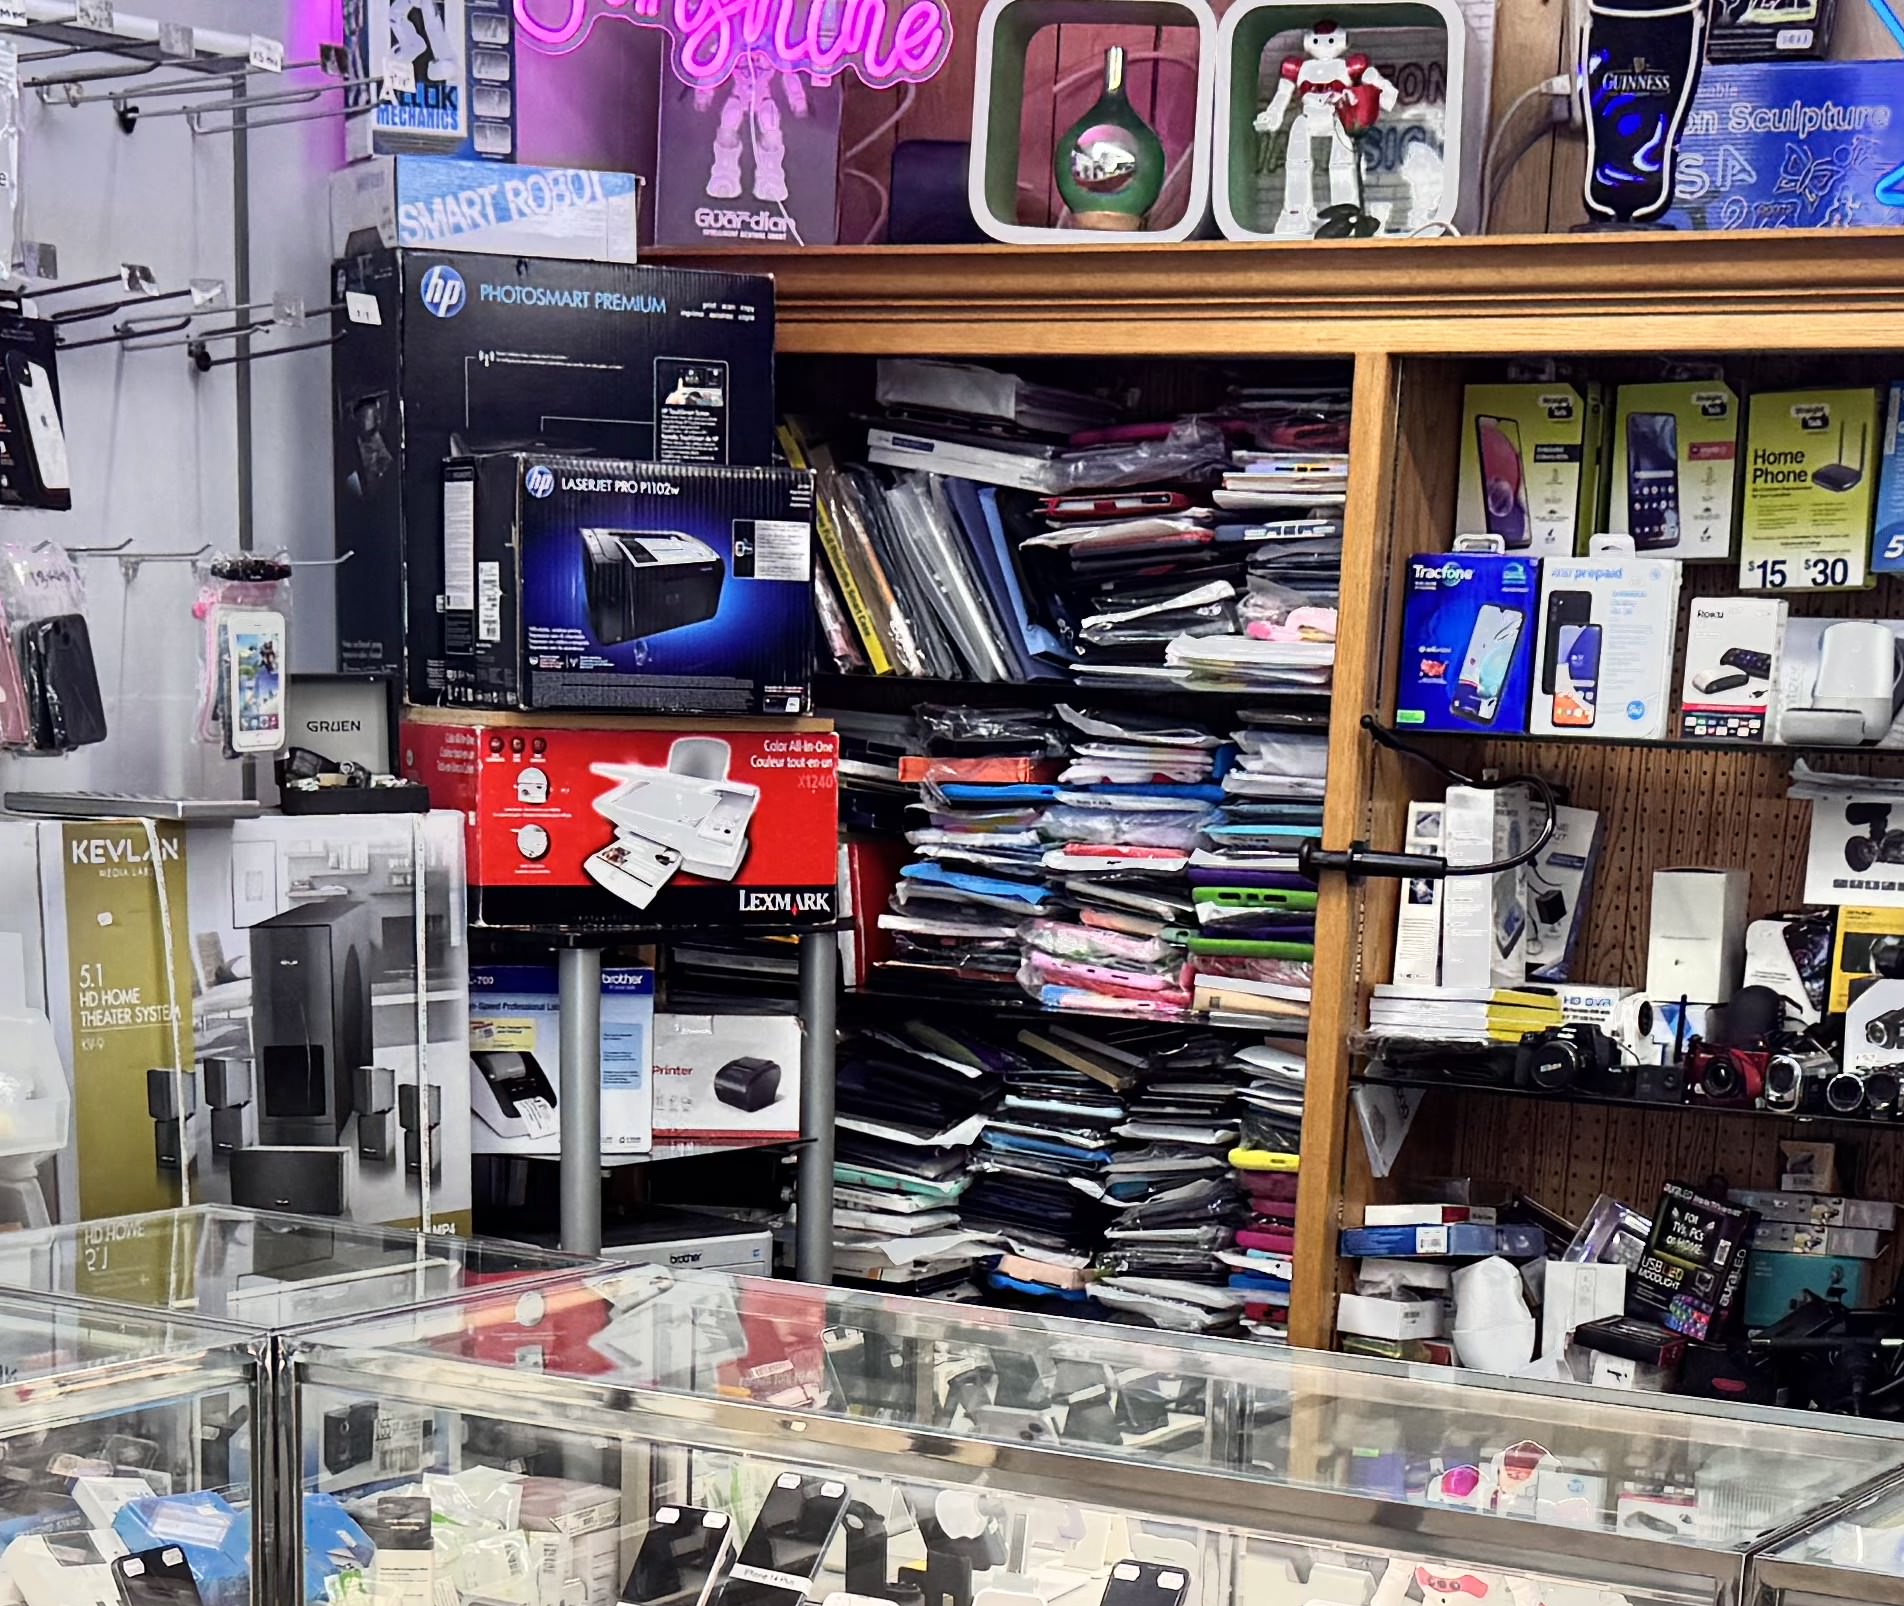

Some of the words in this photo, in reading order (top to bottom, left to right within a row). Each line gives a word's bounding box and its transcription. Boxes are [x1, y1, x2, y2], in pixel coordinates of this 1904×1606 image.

[1602, 73, 1670, 91] GUINNESS
[377, 105, 458, 131] MECHANICS
[1728, 101, 1891, 139] Sculpture
[399, 185, 498, 242] SMART
[695, 208, 797, 232] Guardian
[424, 268, 461, 317] hp
[480, 283, 590, 309] PHOTOSMART
[595, 292, 667, 315] PREMIUM
[1753, 448, 1805, 466] Home
[527, 466, 554, 498] hp
[562, 477, 612, 492] LASERJET
[615, 479, 638, 494] PRO
[1752, 467, 1808, 484] Phone
[1413, 563, 1474, 582] Tracfone
[1748, 559, 1787, 588] $15
[1804, 558, 1849, 587] $30
[306, 719, 361, 733] GRUEN
[763, 739, 787, 754] Color
[798, 774, 834, 790] X1240
[738, 889, 831, 914] LEXMARK
[79, 963, 104, 989] 5.1
[601, 973, 644, 988] brother
[79, 989, 98, 1008] HD
[101, 987, 141, 1006] HOME
[79, 1008, 132, 1027] THEATER
[134, 1004, 183, 1025] SYSTEM
[652, 1065, 694, 1077] Printer
[669, 1251, 702, 1266] brother
[1641, 1255, 1663, 1273] USB
